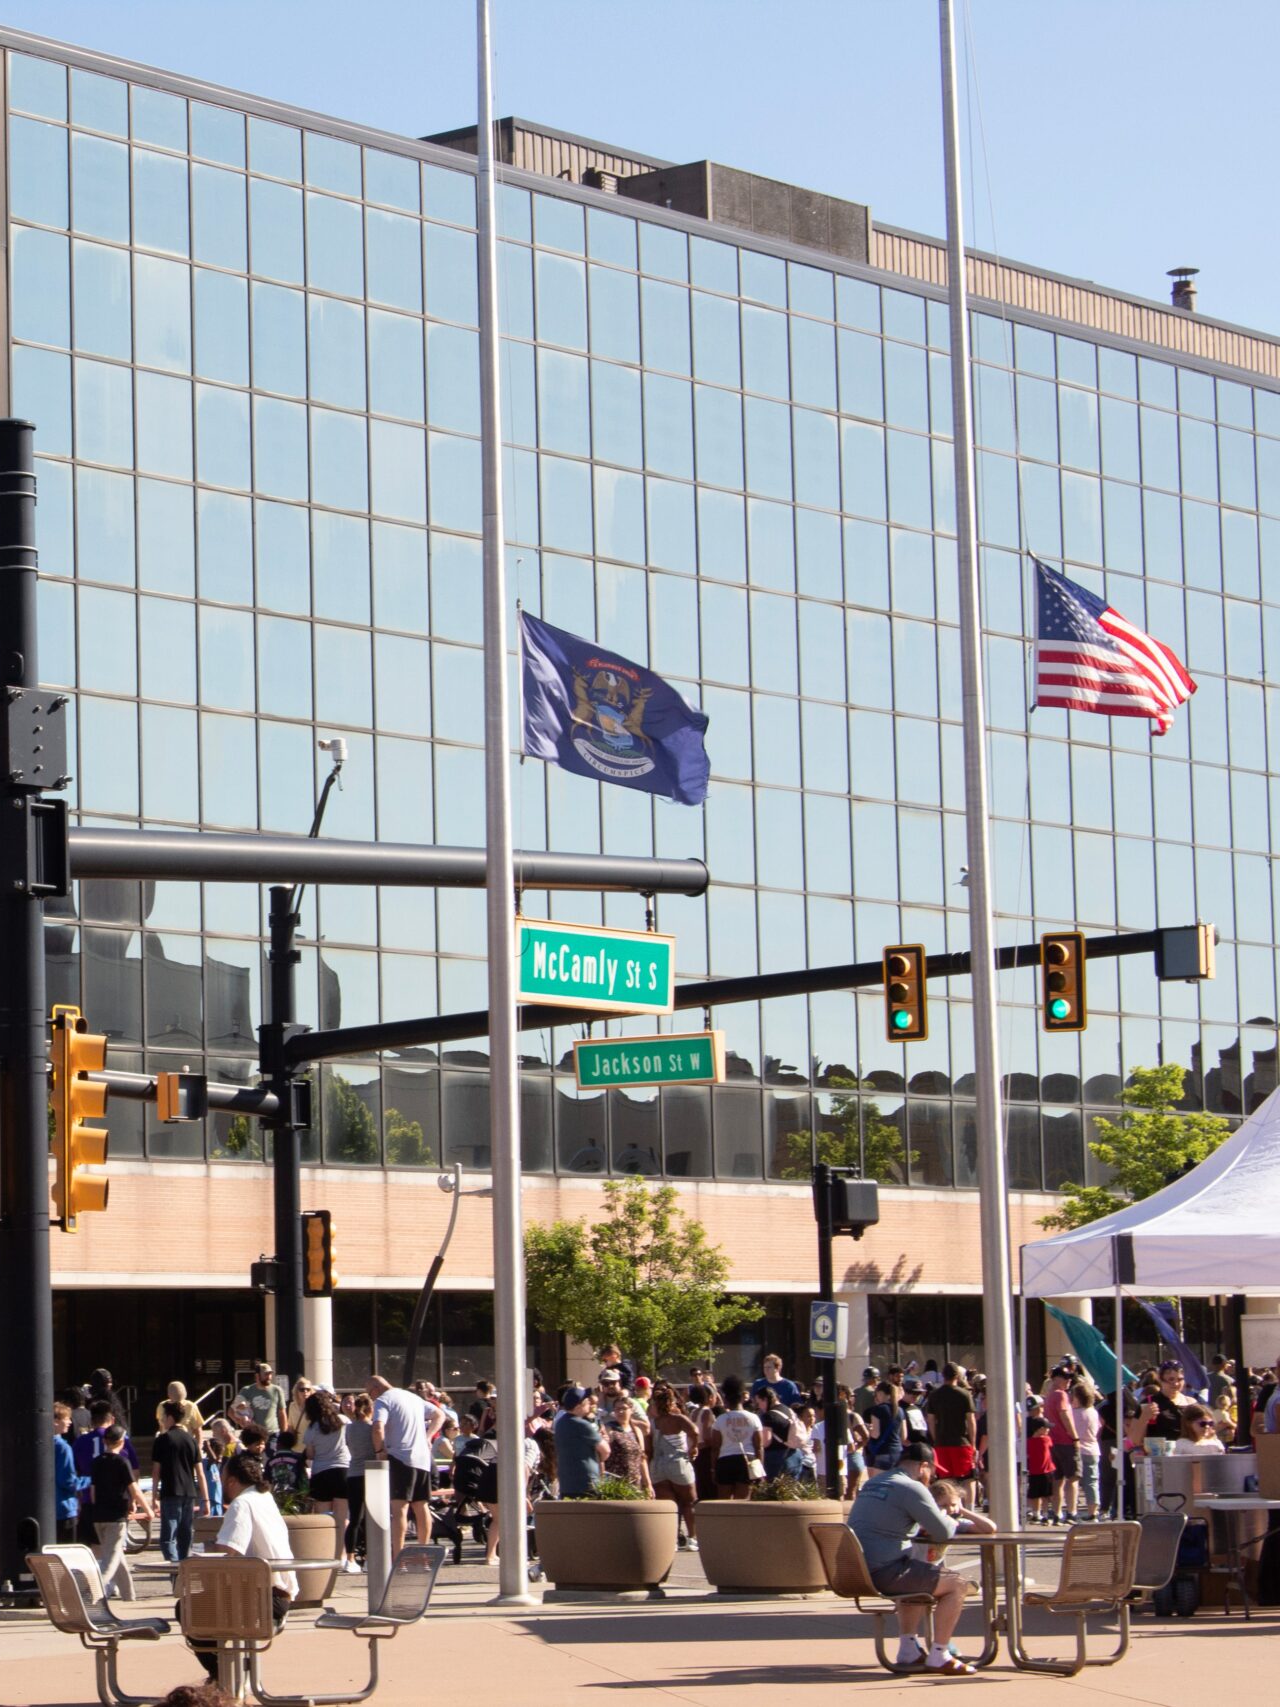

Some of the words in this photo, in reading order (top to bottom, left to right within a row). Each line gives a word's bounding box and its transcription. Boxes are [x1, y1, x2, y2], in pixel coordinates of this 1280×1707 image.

[533, 941, 618, 996] McCamly
[626, 960, 641, 989] St
[649, 962, 657, 991] S
[591, 1052, 662, 1077] Jackson
[669, 1056, 683, 1072] St
[690, 1053, 700, 1071] W
